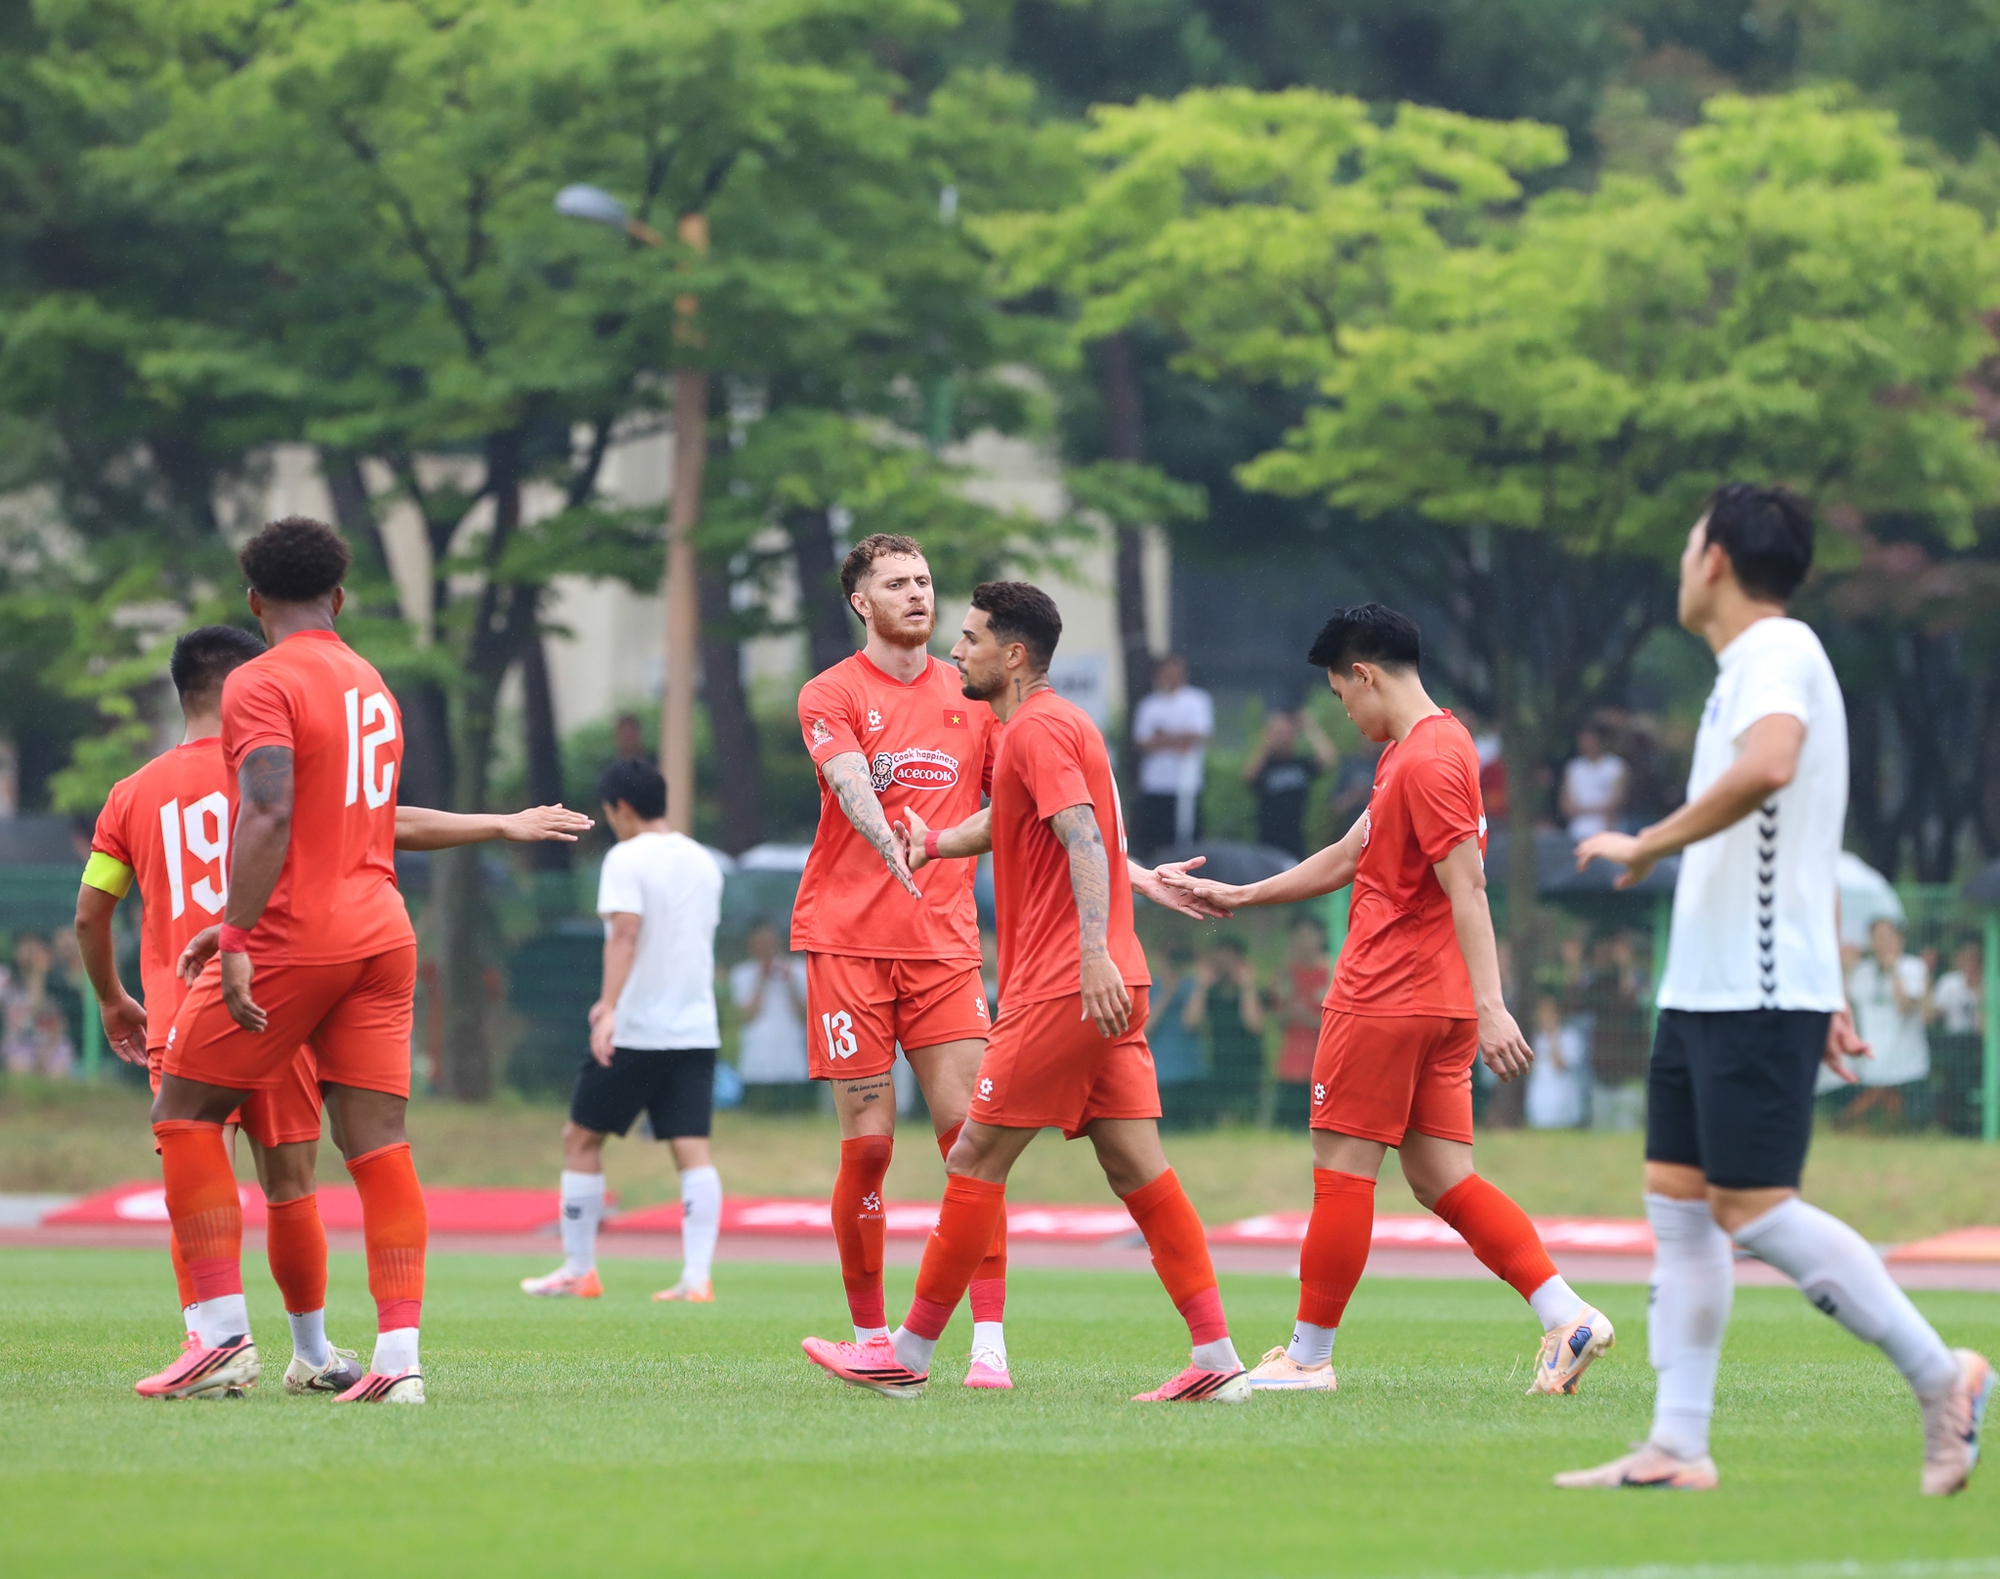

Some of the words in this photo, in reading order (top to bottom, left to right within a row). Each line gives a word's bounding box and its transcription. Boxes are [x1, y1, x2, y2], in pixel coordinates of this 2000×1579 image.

[344, 687, 396, 811] 12
[893, 750, 915, 763] Cook
[916, 749, 958, 768] happiness
[159, 790, 229, 922] 19
[821, 1009, 859, 1061] 13
